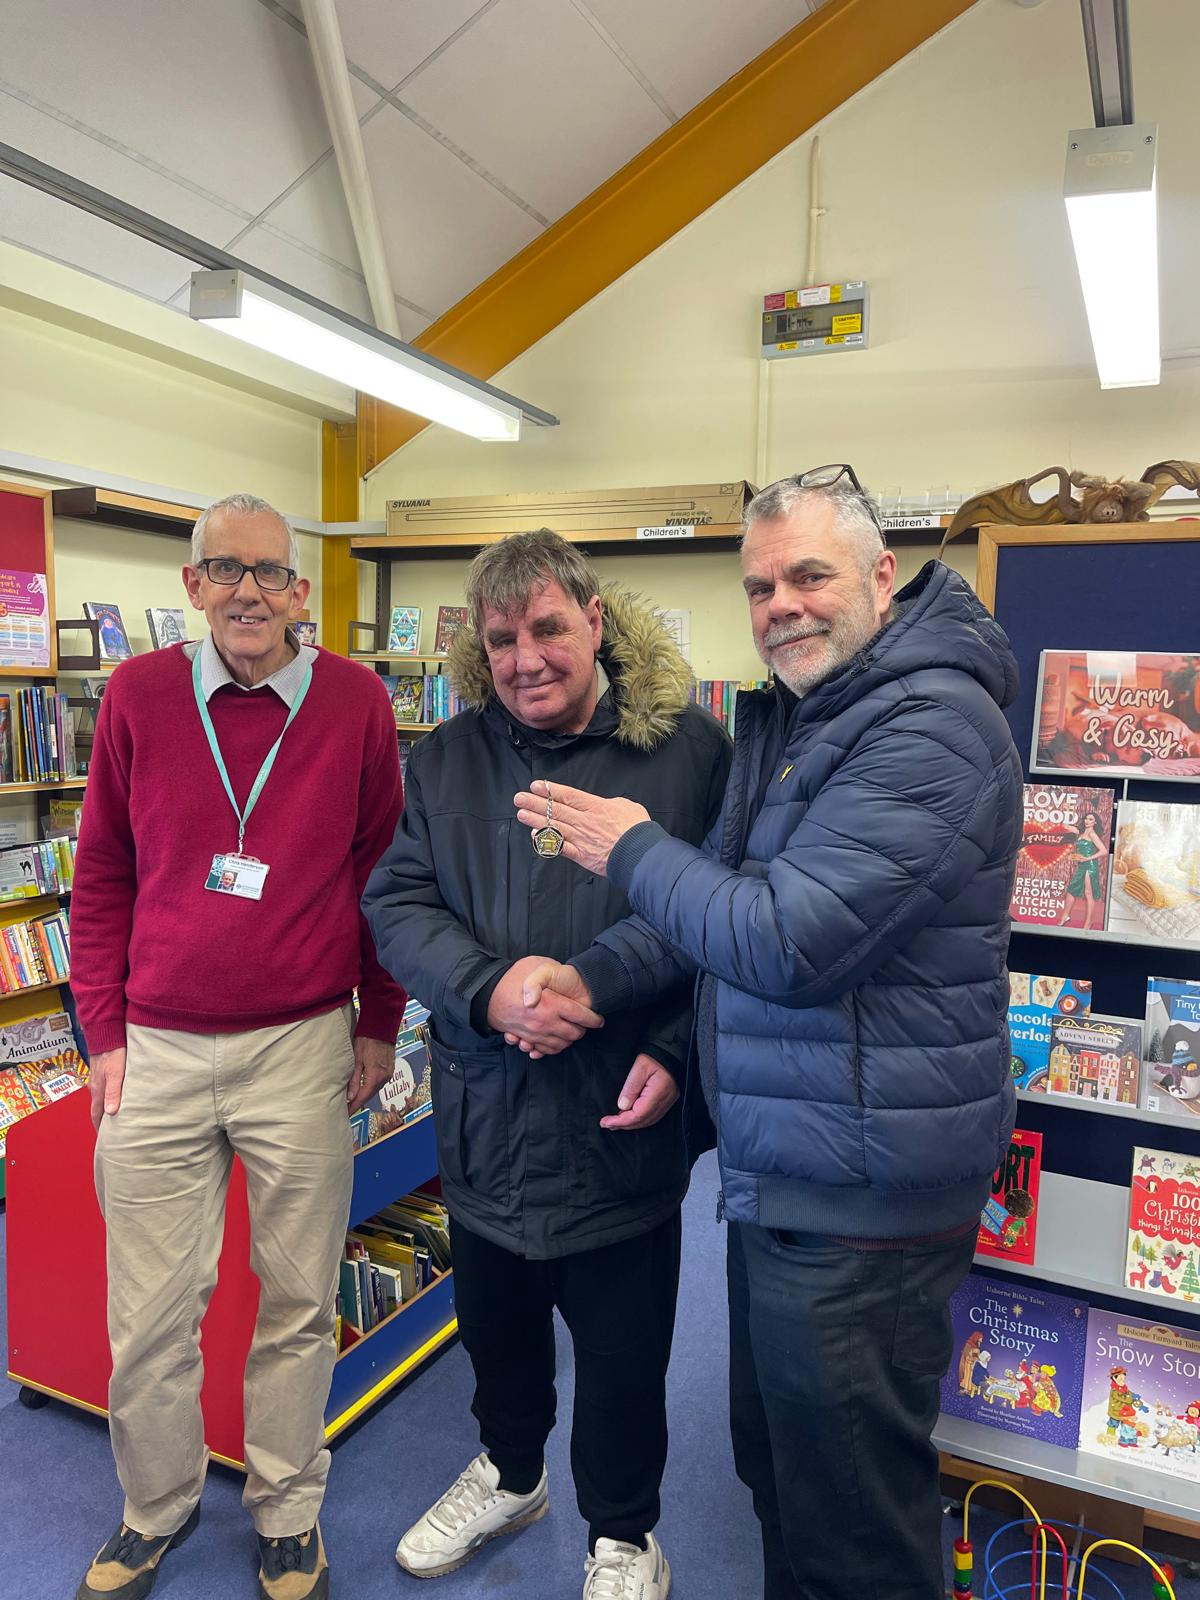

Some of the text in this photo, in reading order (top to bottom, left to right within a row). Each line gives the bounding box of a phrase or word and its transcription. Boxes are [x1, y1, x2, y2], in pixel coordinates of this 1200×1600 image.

[392, 499, 431, 508] SYLVANIA
[665, 516, 713, 526] SYLVANIA
[881, 517, 931, 528] Children's
[643, 527, 687, 537] Children's
[1093, 671, 1175, 709] Warm
[1082, 713, 1178, 759] & Cosy
[1023, 791, 1079, 808] LOVE
[1023, 808, 1079, 825] FOOD
[1026, 834, 1064, 844] FAMILY
[1016, 877, 1065, 890] RECIPES
[1015, 886, 1051, 898] FROM
[1012, 896, 1065, 909] KITCHEN
[1019, 906, 1057, 918] DISCO
[1175, 999, 1196, 1012] Tiny
[1059, 1031, 1115, 1045] ADVENT STREET
[6, 1036, 69, 1059] Animalium
[47, 1075, 70, 1089] WHERE'S
[51, 1081, 74, 1095] WALLY?
[383, 1080, 411, 1101] Lullaby
[1144, 1199, 1200, 1227] Christ
[1138, 1218, 1161, 1233] things
[986, 1285, 1045, 1306] Usborne Bible Tales
[985, 1298, 1008, 1314] The
[969, 1306, 1059, 1343] Christmas
[989, 1328, 1036, 1357] Story
[1119, 1338, 1134, 1348] The
[1123, 1327, 1150, 1339] Usborne
[1152, 1333, 1182, 1347] Farmyard
[1095, 1337, 1154, 1368] Snow
